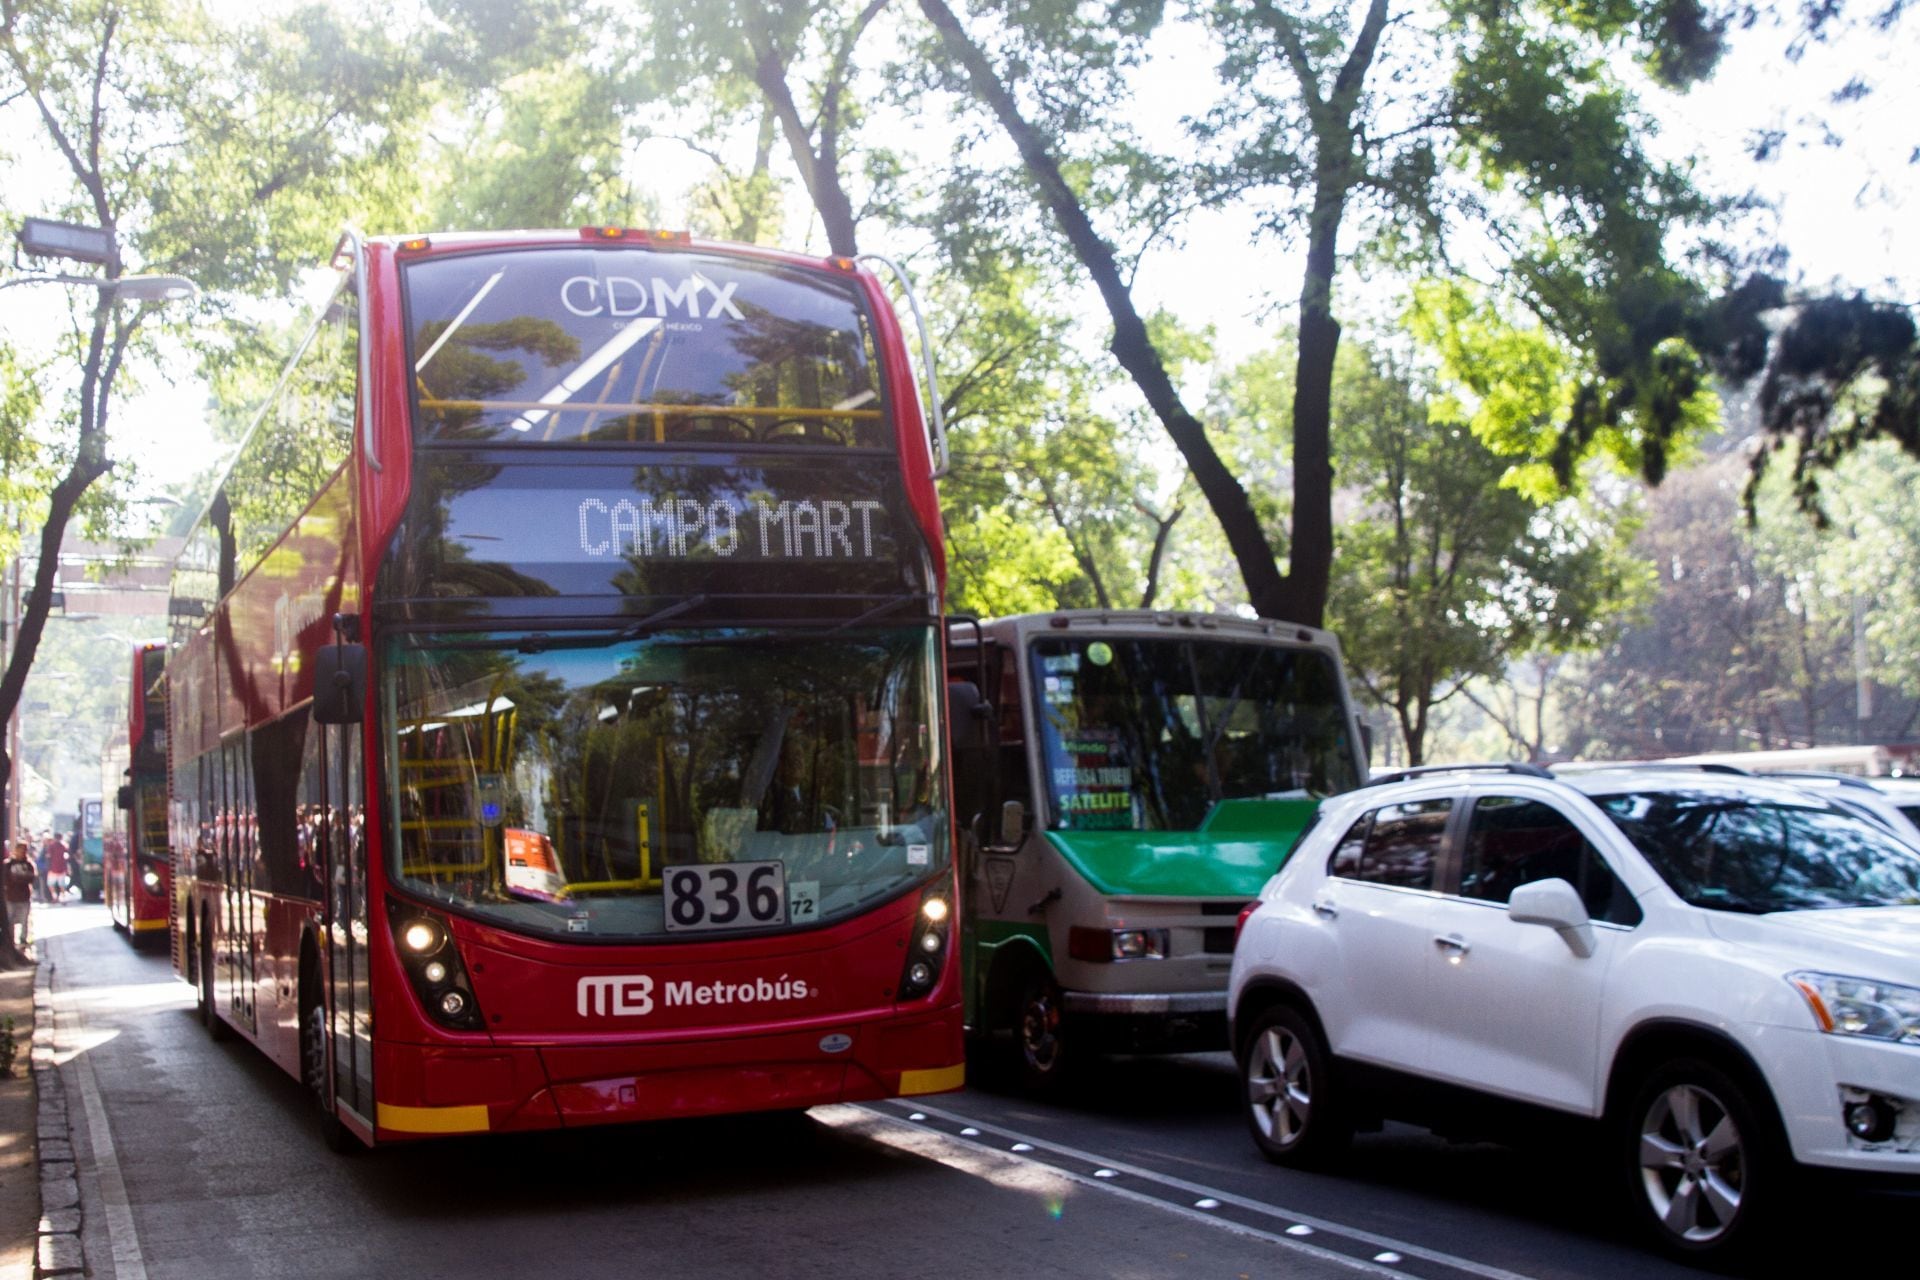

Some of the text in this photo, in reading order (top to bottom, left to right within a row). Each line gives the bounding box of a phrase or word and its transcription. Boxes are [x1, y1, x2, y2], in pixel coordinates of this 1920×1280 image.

[561, 276, 746, 320] CDMX
[579, 498, 880, 557] CAMPO MART
[1060, 791, 1131, 811] SATELITE
[671, 866, 779, 926] 836
[791, 899, 813, 916] 72
[664, 973, 808, 1006] Metrobús
